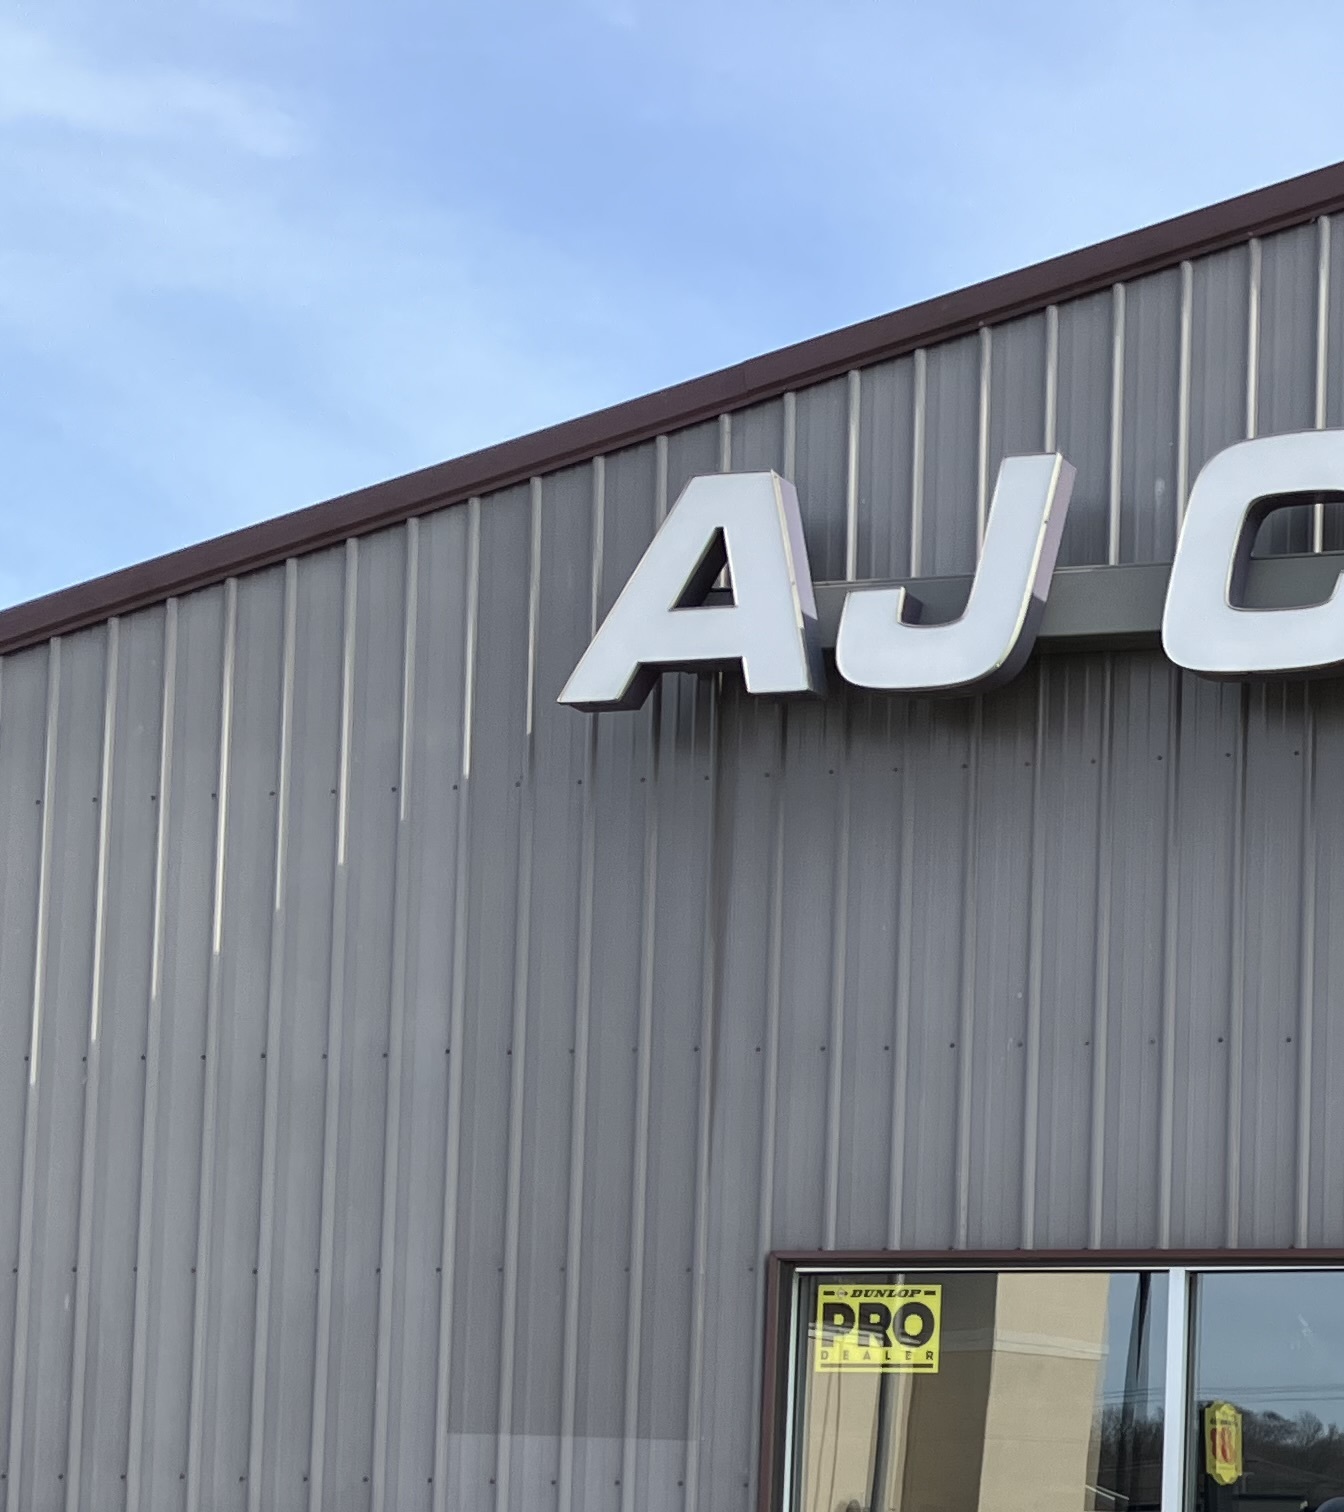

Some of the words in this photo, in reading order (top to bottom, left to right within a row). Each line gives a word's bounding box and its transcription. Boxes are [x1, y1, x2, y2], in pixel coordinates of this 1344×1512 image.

[557, 451, 1076, 709] AJ
[850, 1289, 922, 1298] DUNLOP
[821, 1301, 935, 1348] PRO
[820, 1350, 934, 1361] DEALER
